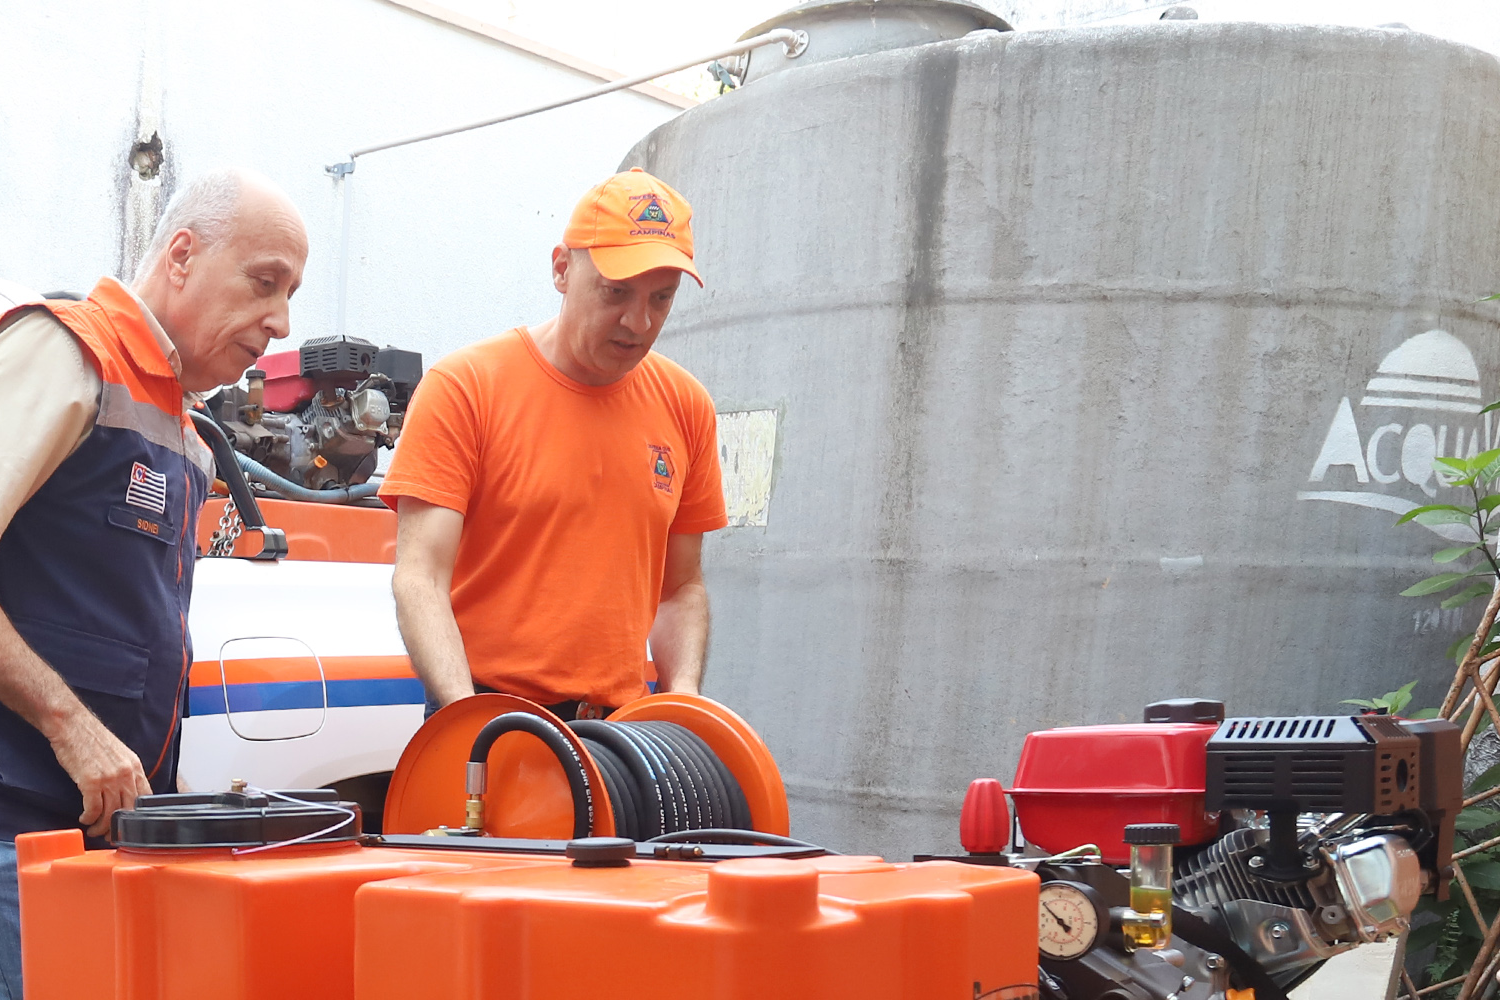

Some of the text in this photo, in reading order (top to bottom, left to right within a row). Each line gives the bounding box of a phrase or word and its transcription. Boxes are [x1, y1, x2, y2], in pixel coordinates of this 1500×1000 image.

[630, 230, 675, 239] CAMPINAS
[1308, 396, 1500, 499] ACQUA
[137, 518, 160, 535] SIDNEI
[580, 769, 590, 786] DIN
